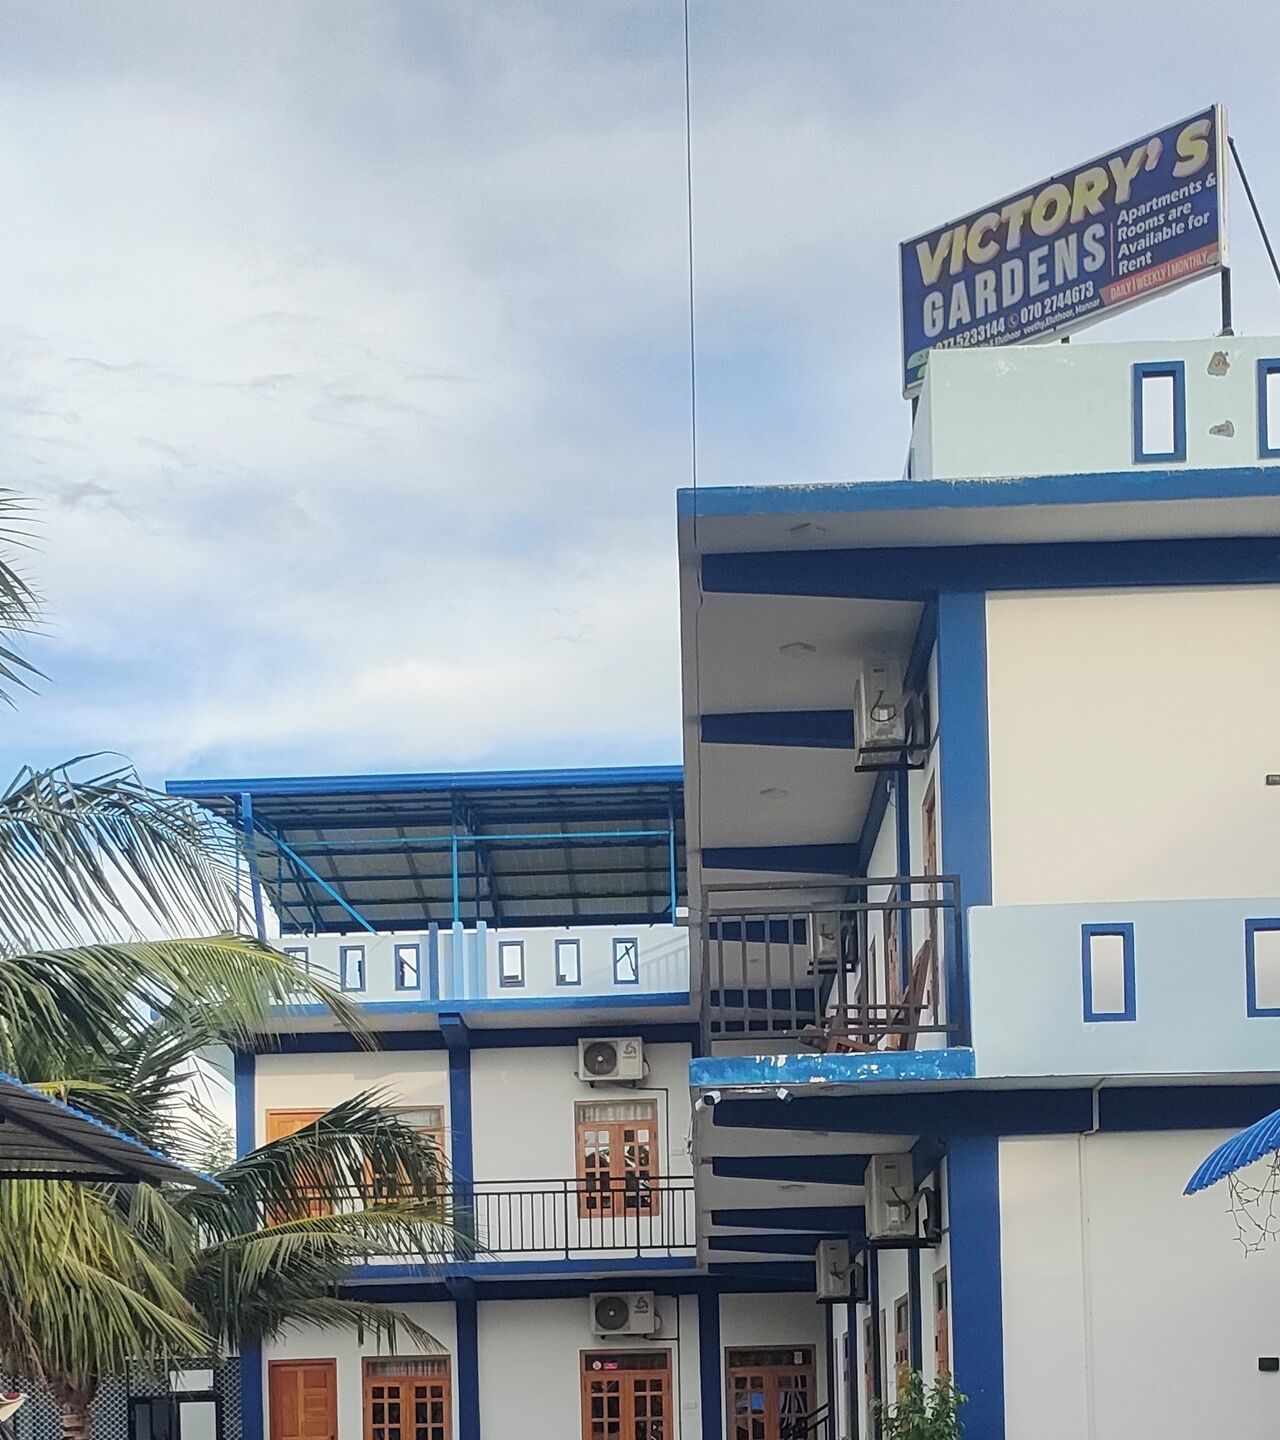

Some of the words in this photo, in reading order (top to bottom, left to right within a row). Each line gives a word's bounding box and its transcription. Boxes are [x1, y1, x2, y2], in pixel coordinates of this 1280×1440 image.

[1117, 180, 1202, 225] Apartments
[1206, 172, 1216, 188] &
[1118, 213, 1165, 241] Rooms
[1168, 202, 1192, 220] are
[1118, 222, 1185, 259] Available
[1188, 212, 1210, 231] for
[923, 223, 1106, 338] GARDENS
[1110, 281, 1132, 300] DAILY
[1136, 268, 1167, 288] WEEKLY
[1171, 251, 1208, 274] MONTHLY
[1119, 251, 1152, 276] Rent
[1021, 303, 1042, 324] 070
[1044, 281, 1094, 315] 2744673
